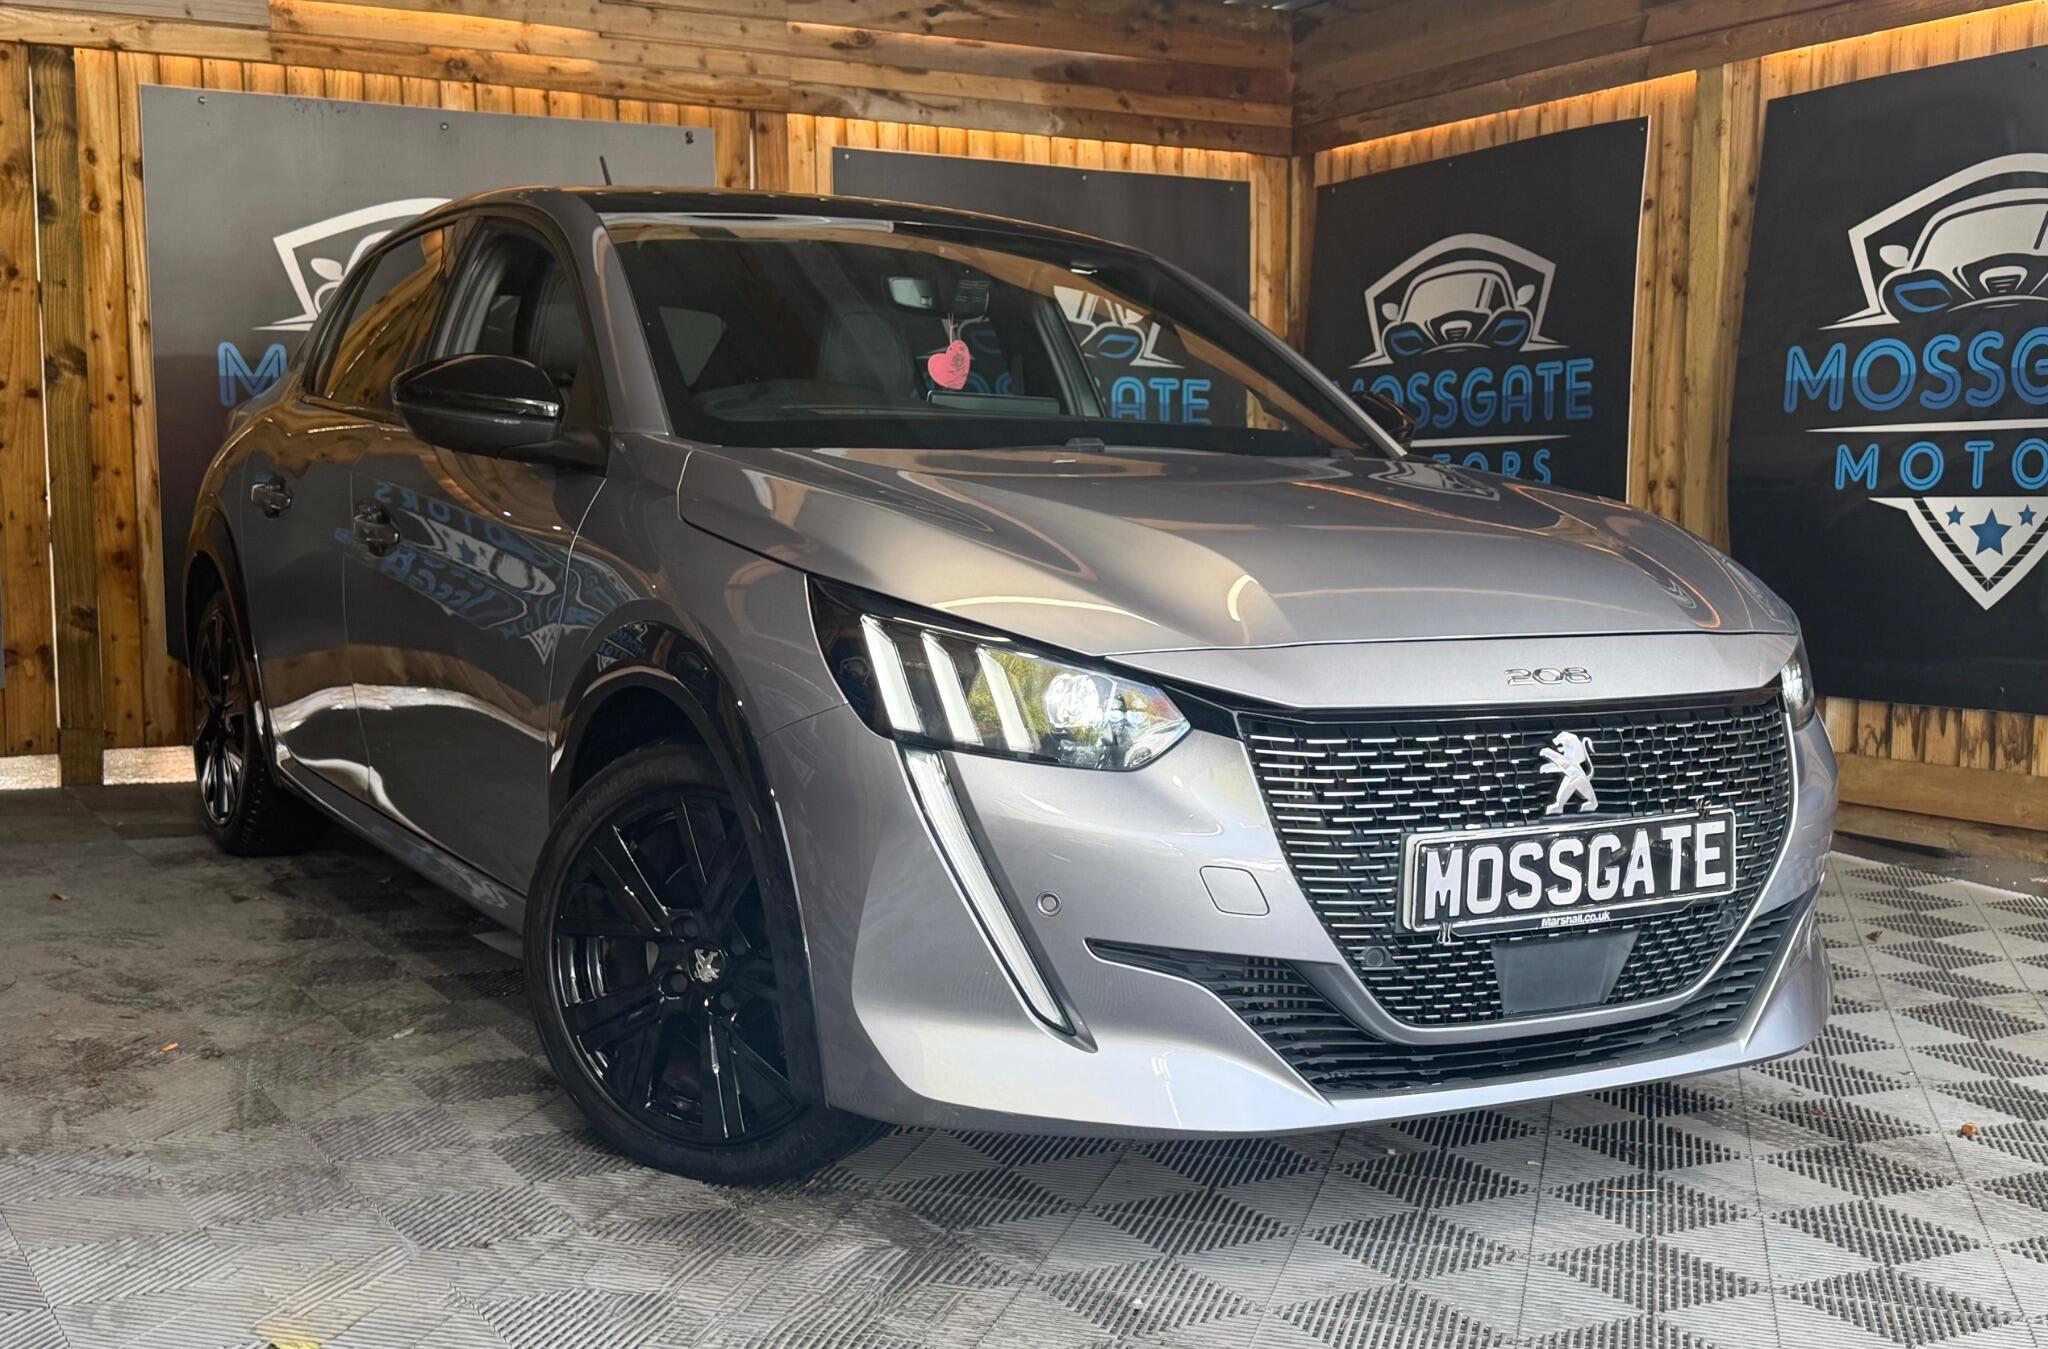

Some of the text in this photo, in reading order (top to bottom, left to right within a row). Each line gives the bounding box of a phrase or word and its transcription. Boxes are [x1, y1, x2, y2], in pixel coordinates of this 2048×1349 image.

[1095, 375, 1213, 425] ATE
[1333, 357, 1595, 429] OSSGATE
[1834, 438, 2048, 491] MOTO
[1504, 667, 1592, 686] 208
[1424, 820, 1726, 920] MOSSGATE
